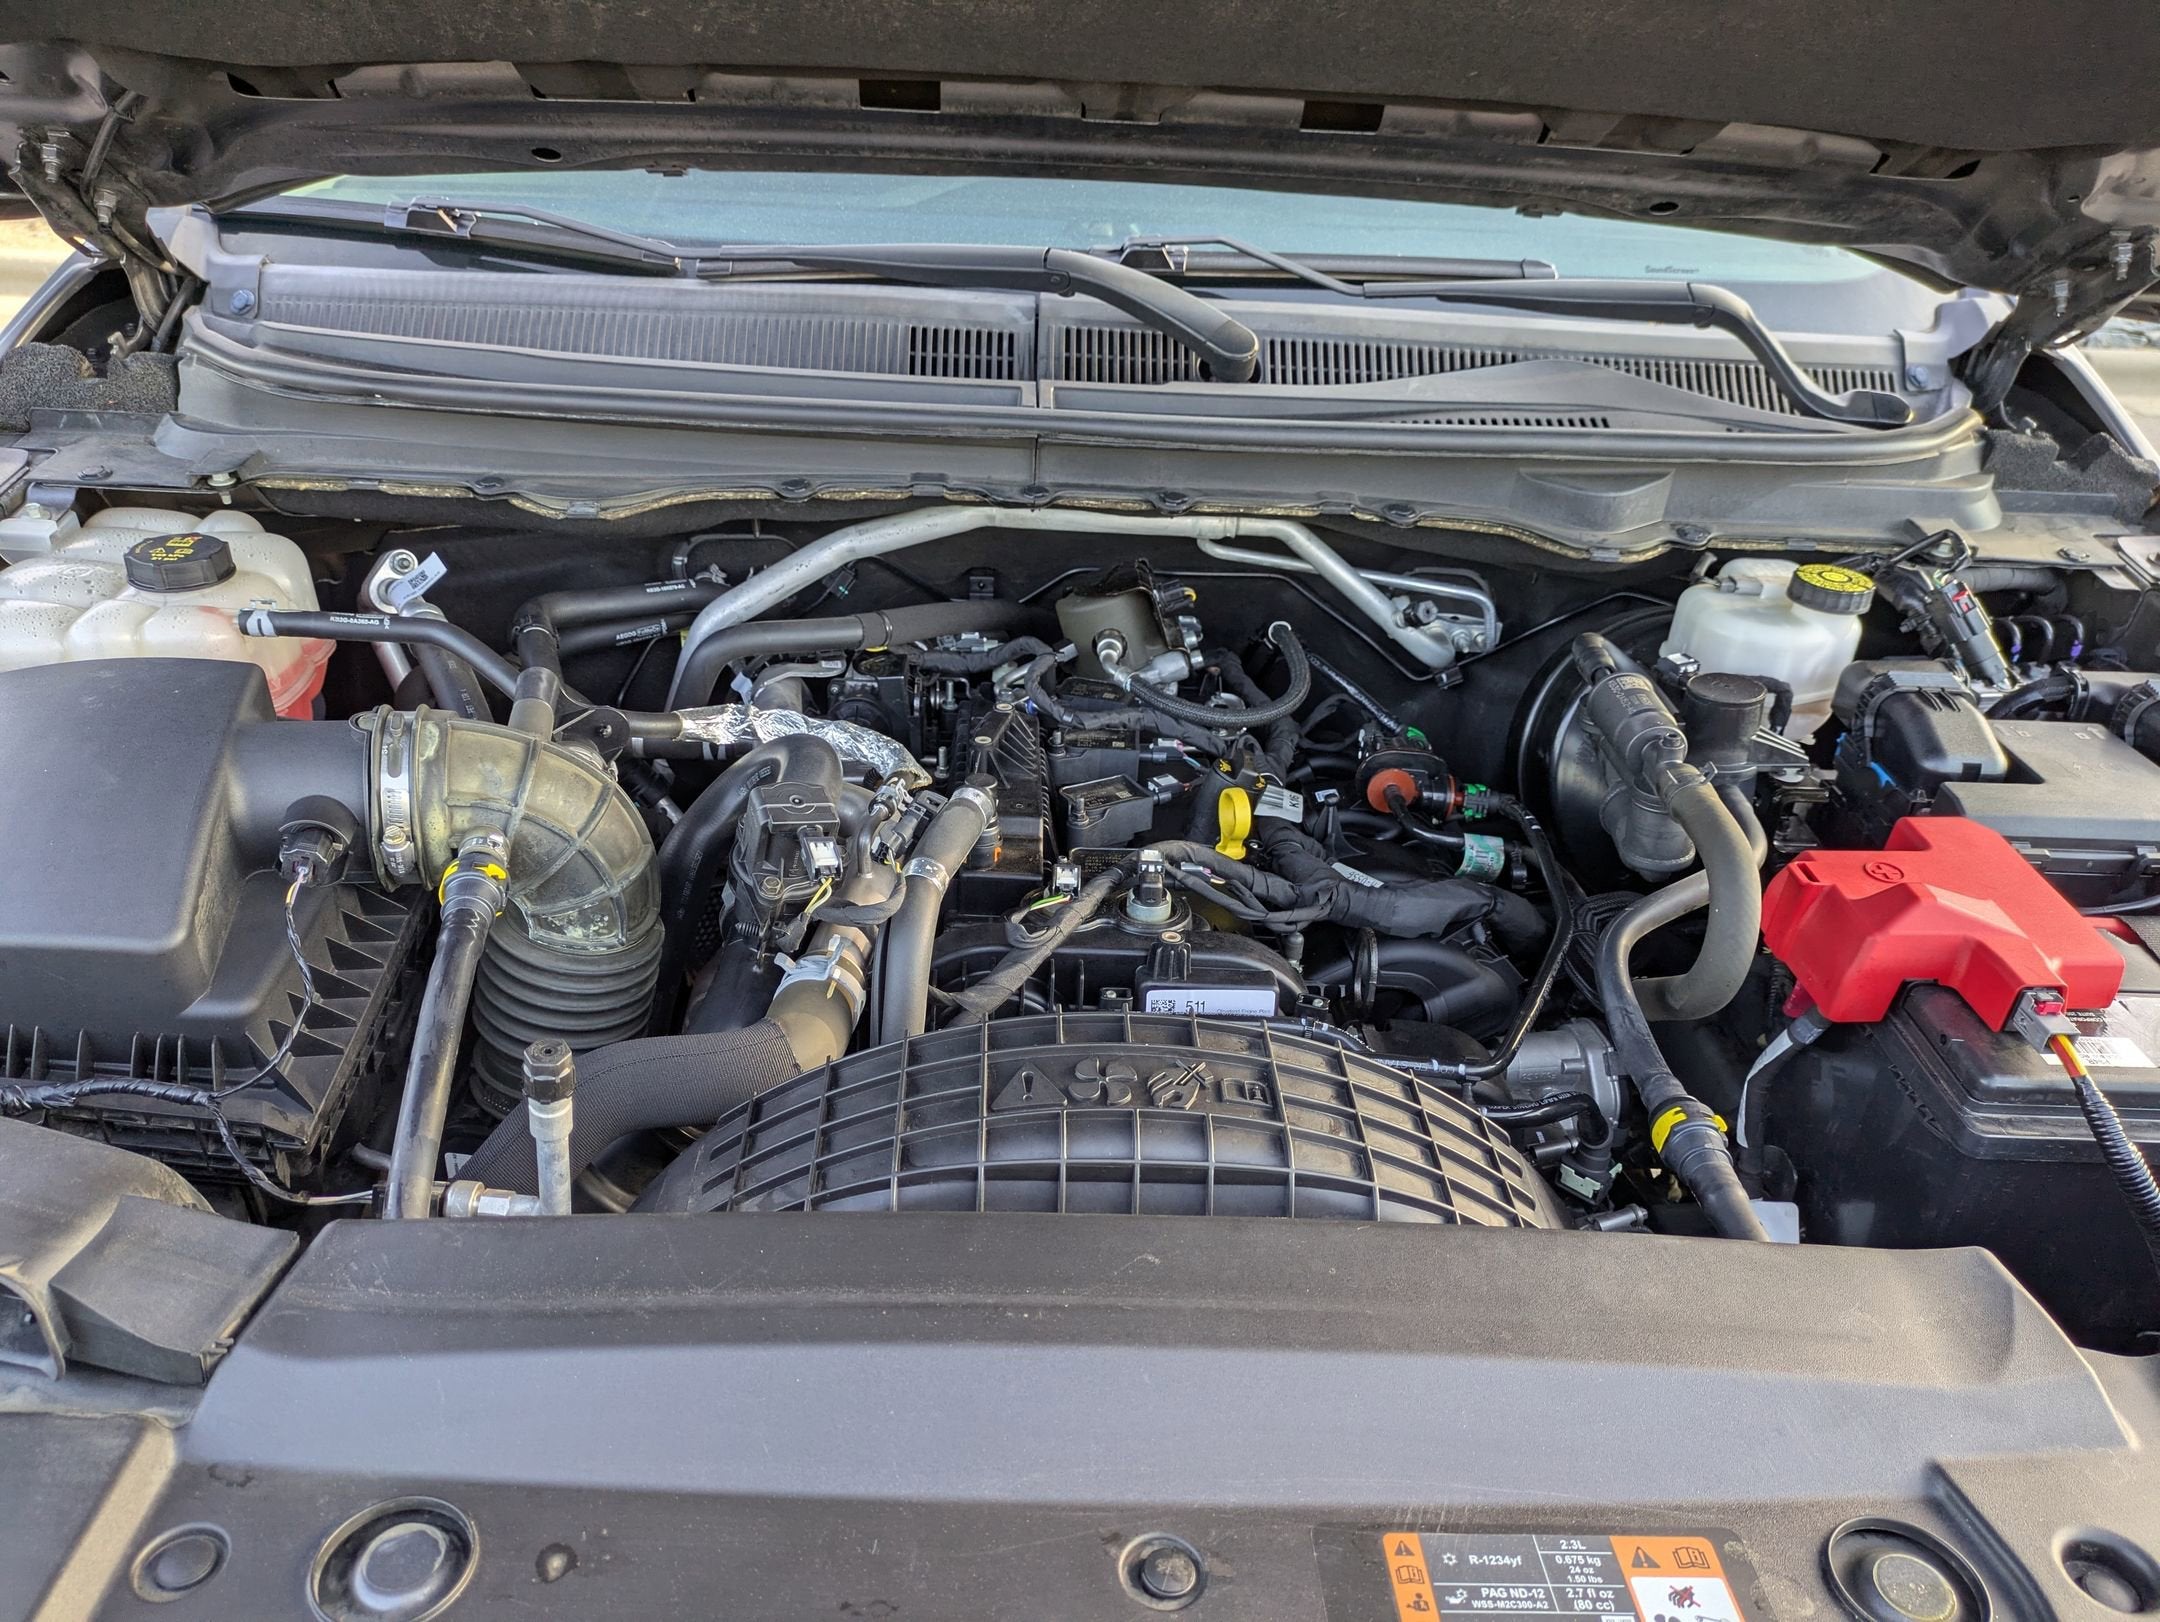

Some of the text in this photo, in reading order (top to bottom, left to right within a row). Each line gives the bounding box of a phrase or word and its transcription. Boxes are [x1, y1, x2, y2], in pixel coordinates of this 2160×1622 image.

[1186, 1001, 1206, 1013] 511
[1559, 1540, 1586, 1550] 2.3L
[1468, 1554, 1522, 1568] R-1234yf
[1555, 1555, 1602, 1567] 0.675 kg
[1569, 1566, 1582, 1574] 24
[1567, 1575, 1603, 1583] 1.50 lbs
[1481, 1587, 1546, 1599] PAG ND-12
[1566, 1587, 1615, 1599] 2.7 fl oz
[1471, 1599, 1549, 1610] WSS-M2C300-A2
[1573, 1600, 1615, 1612] (80 cc)
